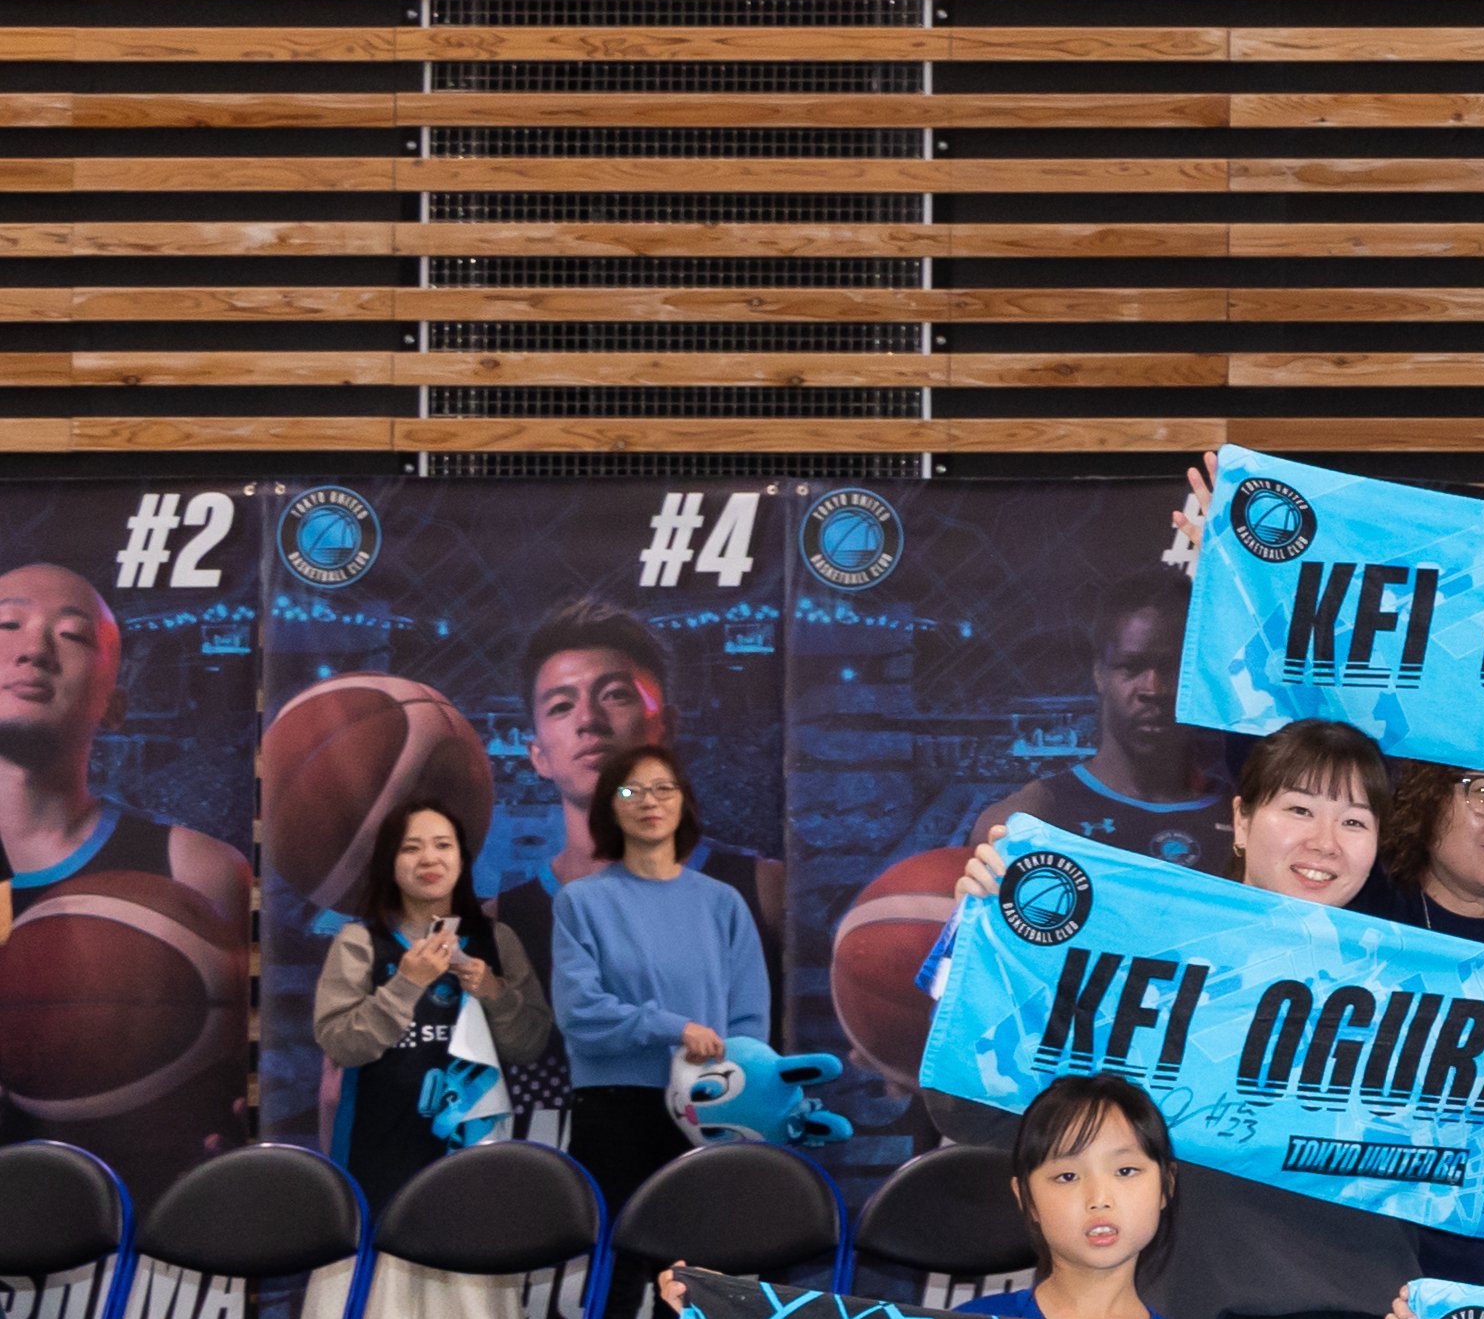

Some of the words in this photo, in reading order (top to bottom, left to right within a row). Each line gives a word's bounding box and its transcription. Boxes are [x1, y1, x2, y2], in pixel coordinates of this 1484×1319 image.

[290, 491, 326, 518] TOKYO
[329, 491, 369, 520] UNITED
[116, 492, 235, 588] #2
[638, 492, 760, 588] #4
[288, 551, 348, 581] BASKETBALL
[347, 551, 370, 575] CLUB
[1016, 854, 1054, 873] TOKYO
[1057, 856, 1089, 892] UNITED
[1002, 902, 1053, 943] BASKETBALL
[1055, 920, 1079, 941] CLUB
[1287, 1139, 1357, 1176] TOKYO
[1357, 1143, 1432, 1181] UNITED
[1434, 1148, 1467, 1184] BC
